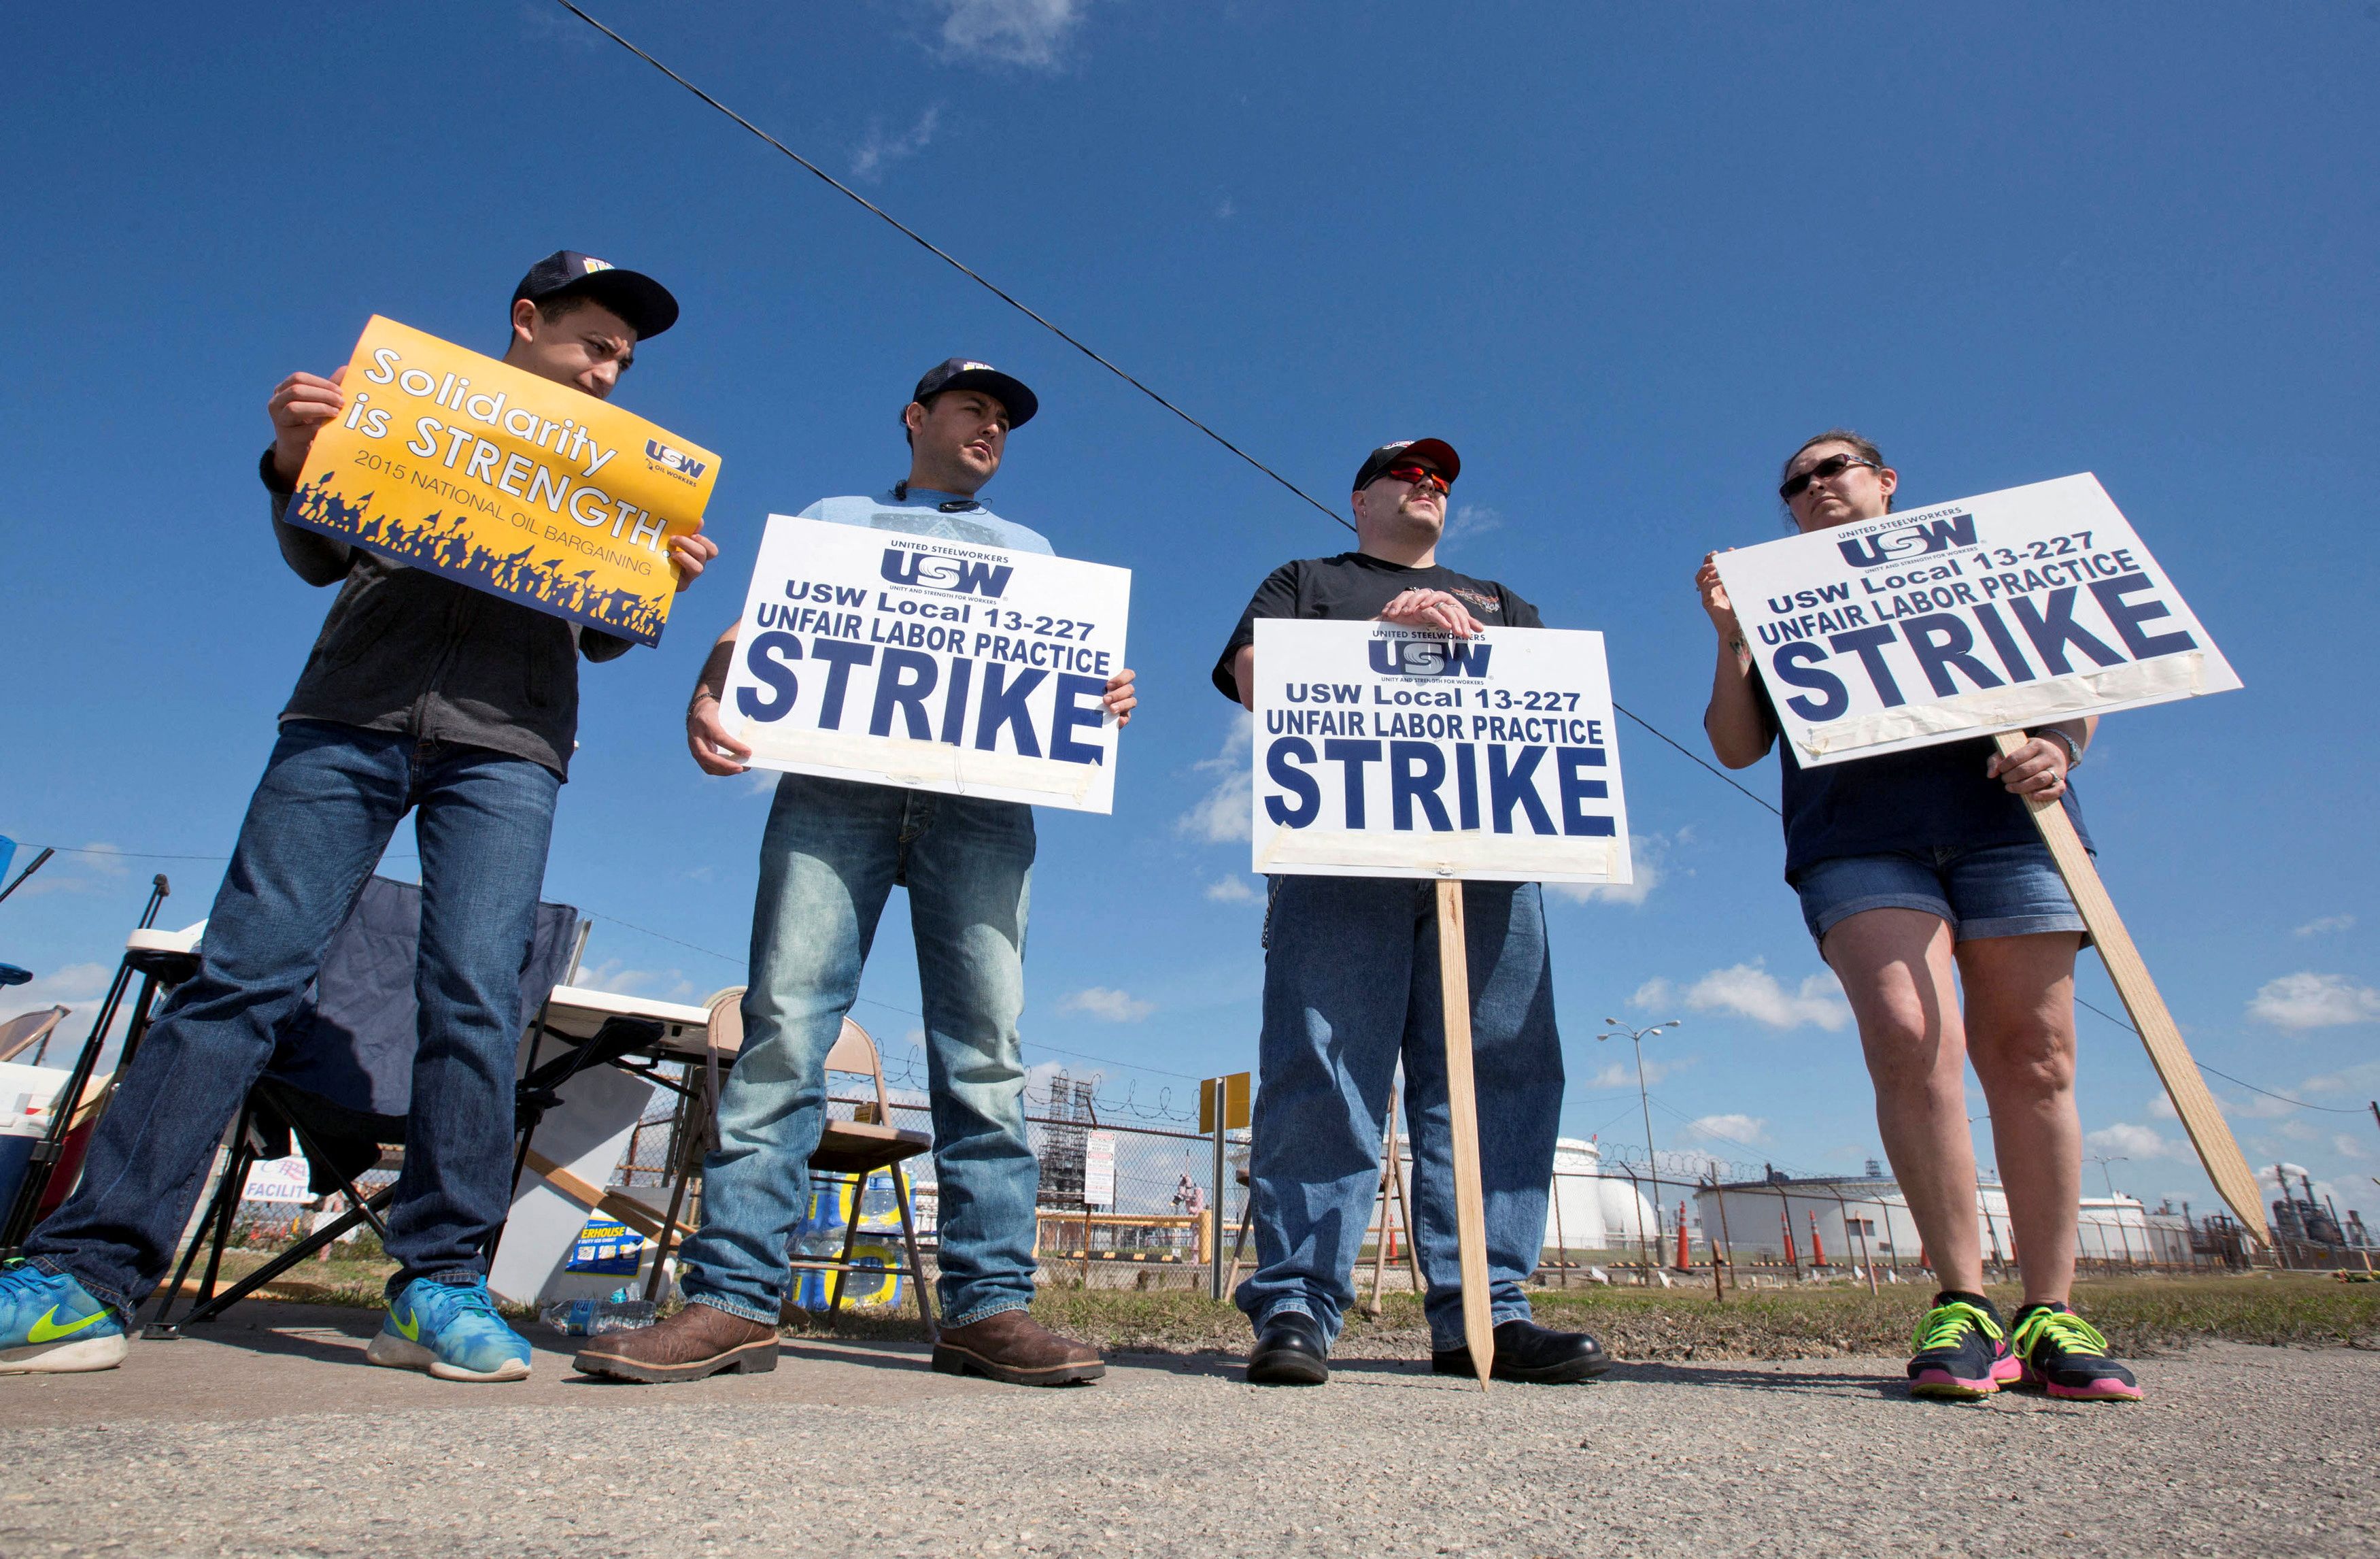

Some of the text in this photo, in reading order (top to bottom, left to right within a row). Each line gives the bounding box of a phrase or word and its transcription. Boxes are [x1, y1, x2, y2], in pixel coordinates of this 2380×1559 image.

[364, 347, 618, 478] Solidarity
[344, 392, 670, 558] is STRENGTH.
[645, 438, 707, 479] USW
[654, 465, 697, 487] OIL WORKERS
[354, 449, 652, 576] 2015 NATIONAL OIL BARGAINING
[1838, 507, 1961, 538] UNITED STEELWORKERS
[891, 541, 1008, 562] UNITED STEELWORKERS
[1837, 514, 1977, 567] USW
[1901, 556, 1933, 566] STRENGTH
[1946, 547, 1978, 557] WORKERS
[881, 549, 1013, 598] USW
[924, 590, 953, 599] STRENGTH
[1768, 531, 2092, 614] USW Local 13-227
[786, 580, 1094, 641] USW Local 13-227
[1757, 550, 2140, 645] UNFAIR LABOR PRACTICE
[758, 603, 1110, 675] UNFAIR LABOR PRACTICE
[1368, 639, 1492, 677] USW
[1372, 630, 1486, 641] UNITED STEELWORERS
[1773, 573, 2198, 722] STRIKE
[736, 631, 1109, 767] STRIKE
[1287, 684, 1580, 711] USW Local 13-227
[1268, 710, 1603, 744] UNFAIR LABOR PRACTICE
[1265, 737, 1616, 837] STRIKE
[246, 1183, 307, 1198] FACILIT
[581, 1226, 626, 1239] ERHOUSE
